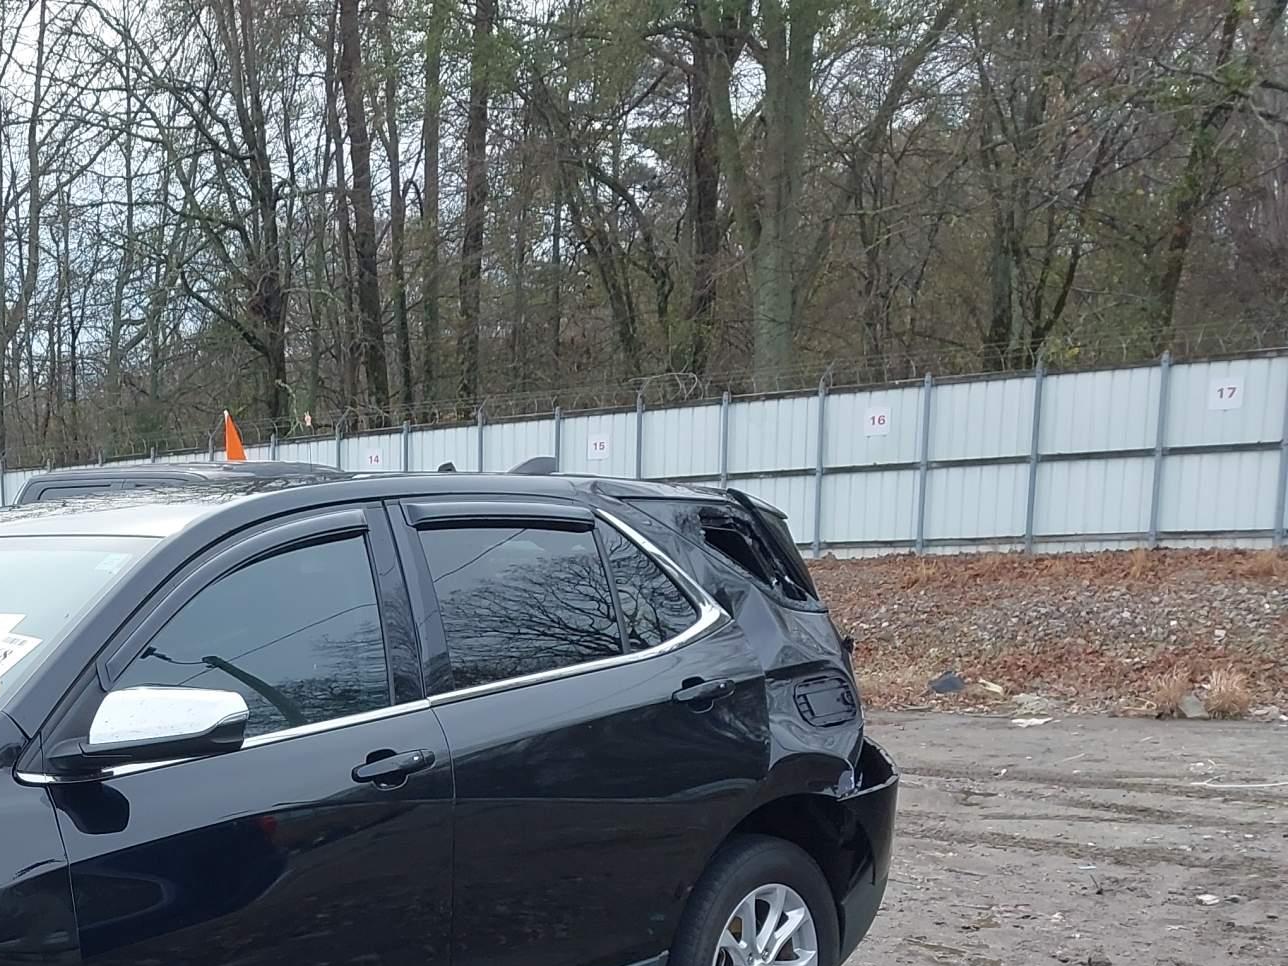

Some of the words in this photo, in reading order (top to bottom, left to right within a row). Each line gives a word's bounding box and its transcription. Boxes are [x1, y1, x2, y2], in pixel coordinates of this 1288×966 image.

[1217, 386, 1237, 399] 17
[870, 415, 886, 426] 16
[593, 441, 605, 451] 15
[369, 455, 380, 465] 14
